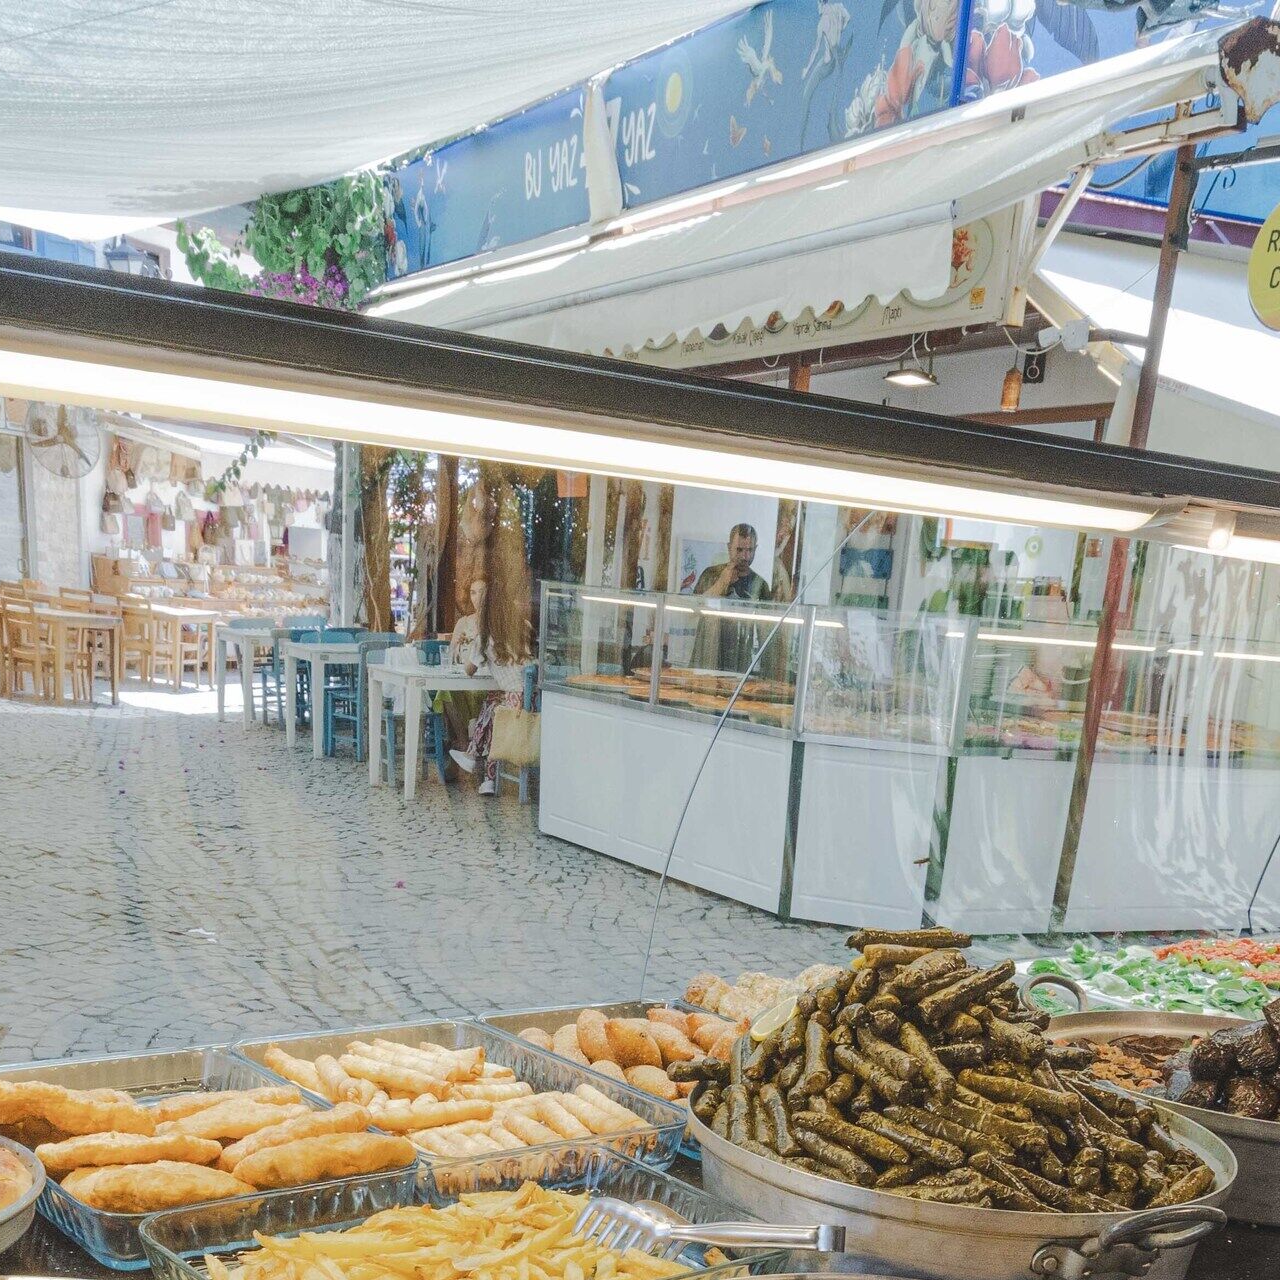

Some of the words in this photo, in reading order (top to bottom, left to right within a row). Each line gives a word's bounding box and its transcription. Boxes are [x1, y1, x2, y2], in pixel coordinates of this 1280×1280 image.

[525, 149, 542, 201] BU
[549, 133, 579, 193] YAZ
[622, 101, 657, 168] YAZ
